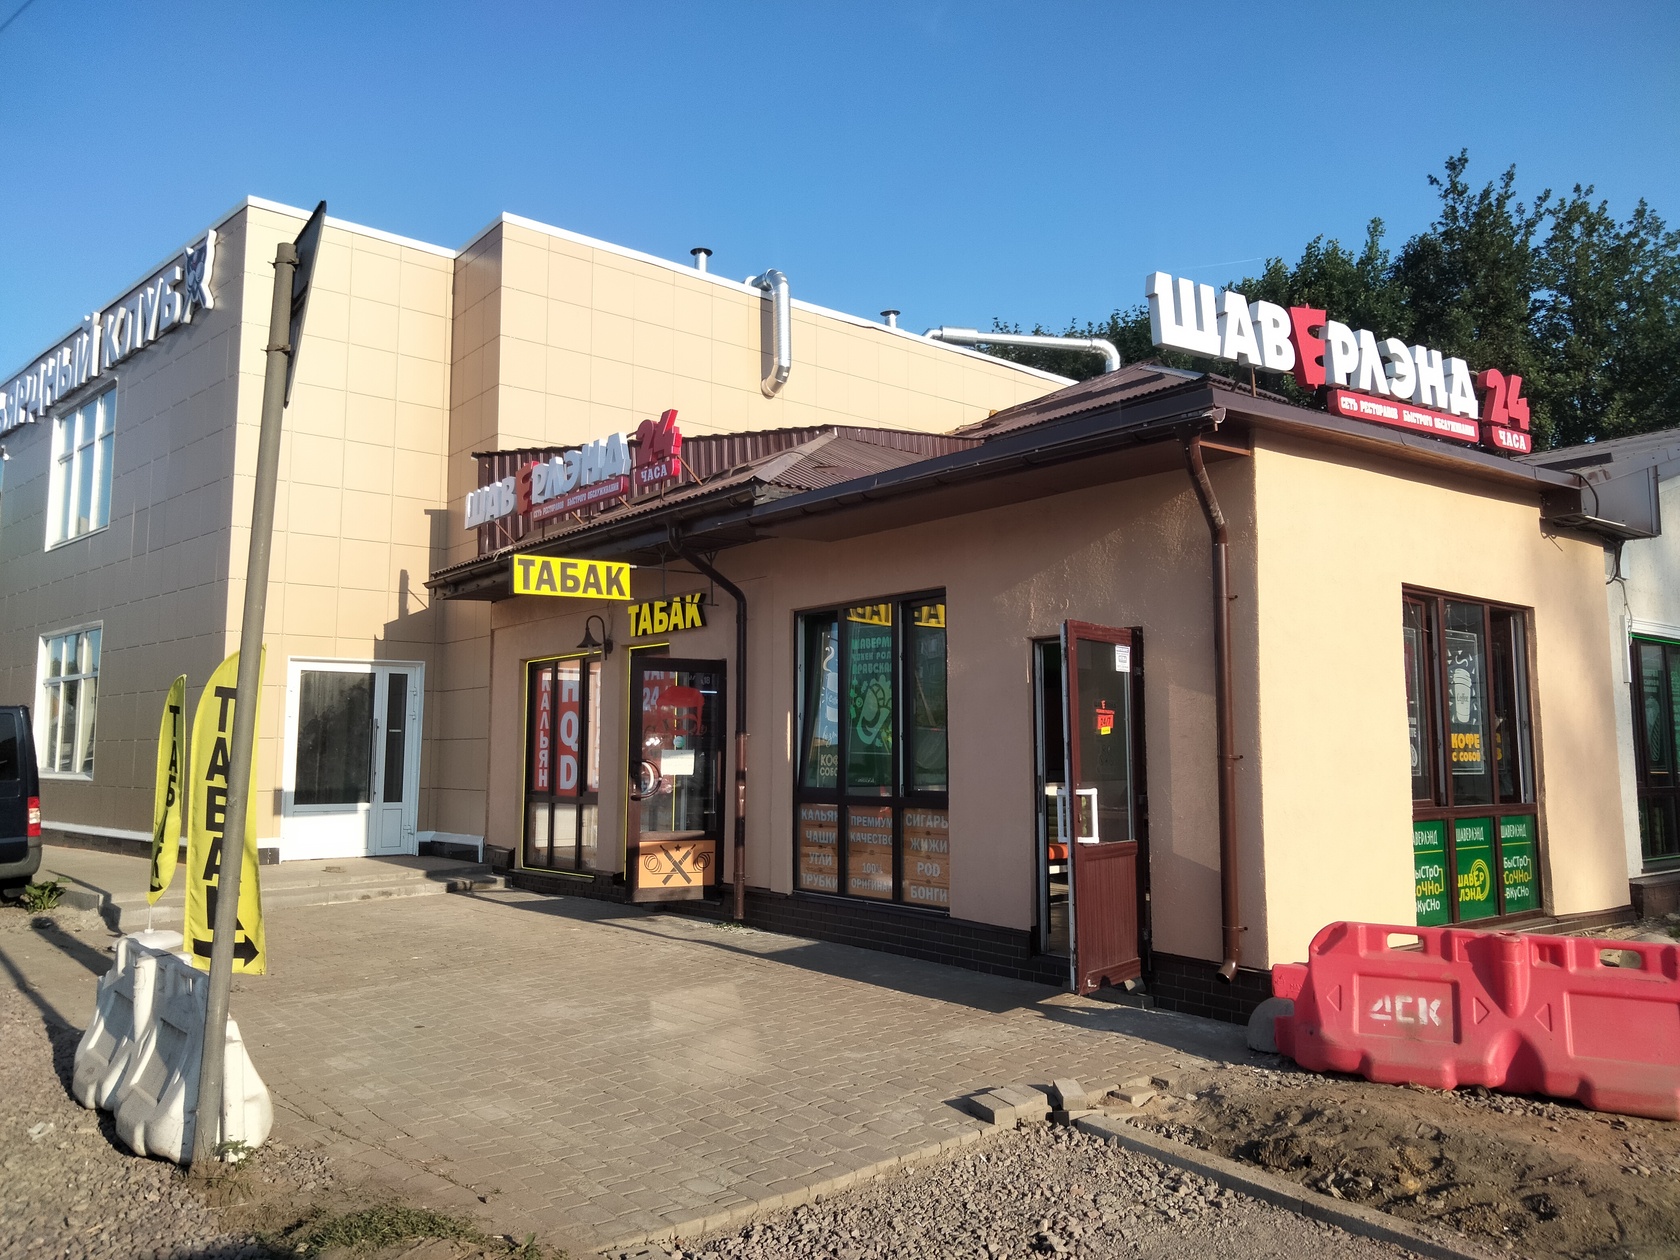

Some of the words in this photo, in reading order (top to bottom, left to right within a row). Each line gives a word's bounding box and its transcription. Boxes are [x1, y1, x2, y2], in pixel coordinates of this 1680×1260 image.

[104, 266, 184, 369] КЛУБ
[1146, 271, 1479, 419] ШАВЕРЛЭНД
[1477, 368, 1530, 430] 24
[1340, 396, 1358, 411] СЕТЬ
[1360, 400, 1398, 420] РЕСТОРАНОВ
[1403, 409, 1433, 427] БЫСТРОГО
[636, 409, 682, 466] 24
[1498, 429, 1527, 450] ЧАСА
[465, 432, 631, 530] ШАВЕРЛЭНД
[641, 463, 668, 482] ЧАСА
[517, 558, 627, 597] ТАБАК
[627, 593, 704, 637] ТАБАК
[852, 636, 892, 650] ШАВЕРМ
[560, 669, 579, 790] HQD
[1451, 733, 1480, 749] КОФЕ
[1452, 753, 1457, 762] С
[1459, 750, 1481, 762] СОБОЙ
[805, 830, 836, 844] ЧАШИ
[910, 837, 948, 853] ЖИЖИ
[808, 852, 833, 866] УГЛИ
[916, 861, 941, 877] POD
[910, 885, 948, 903] БОНГИ
